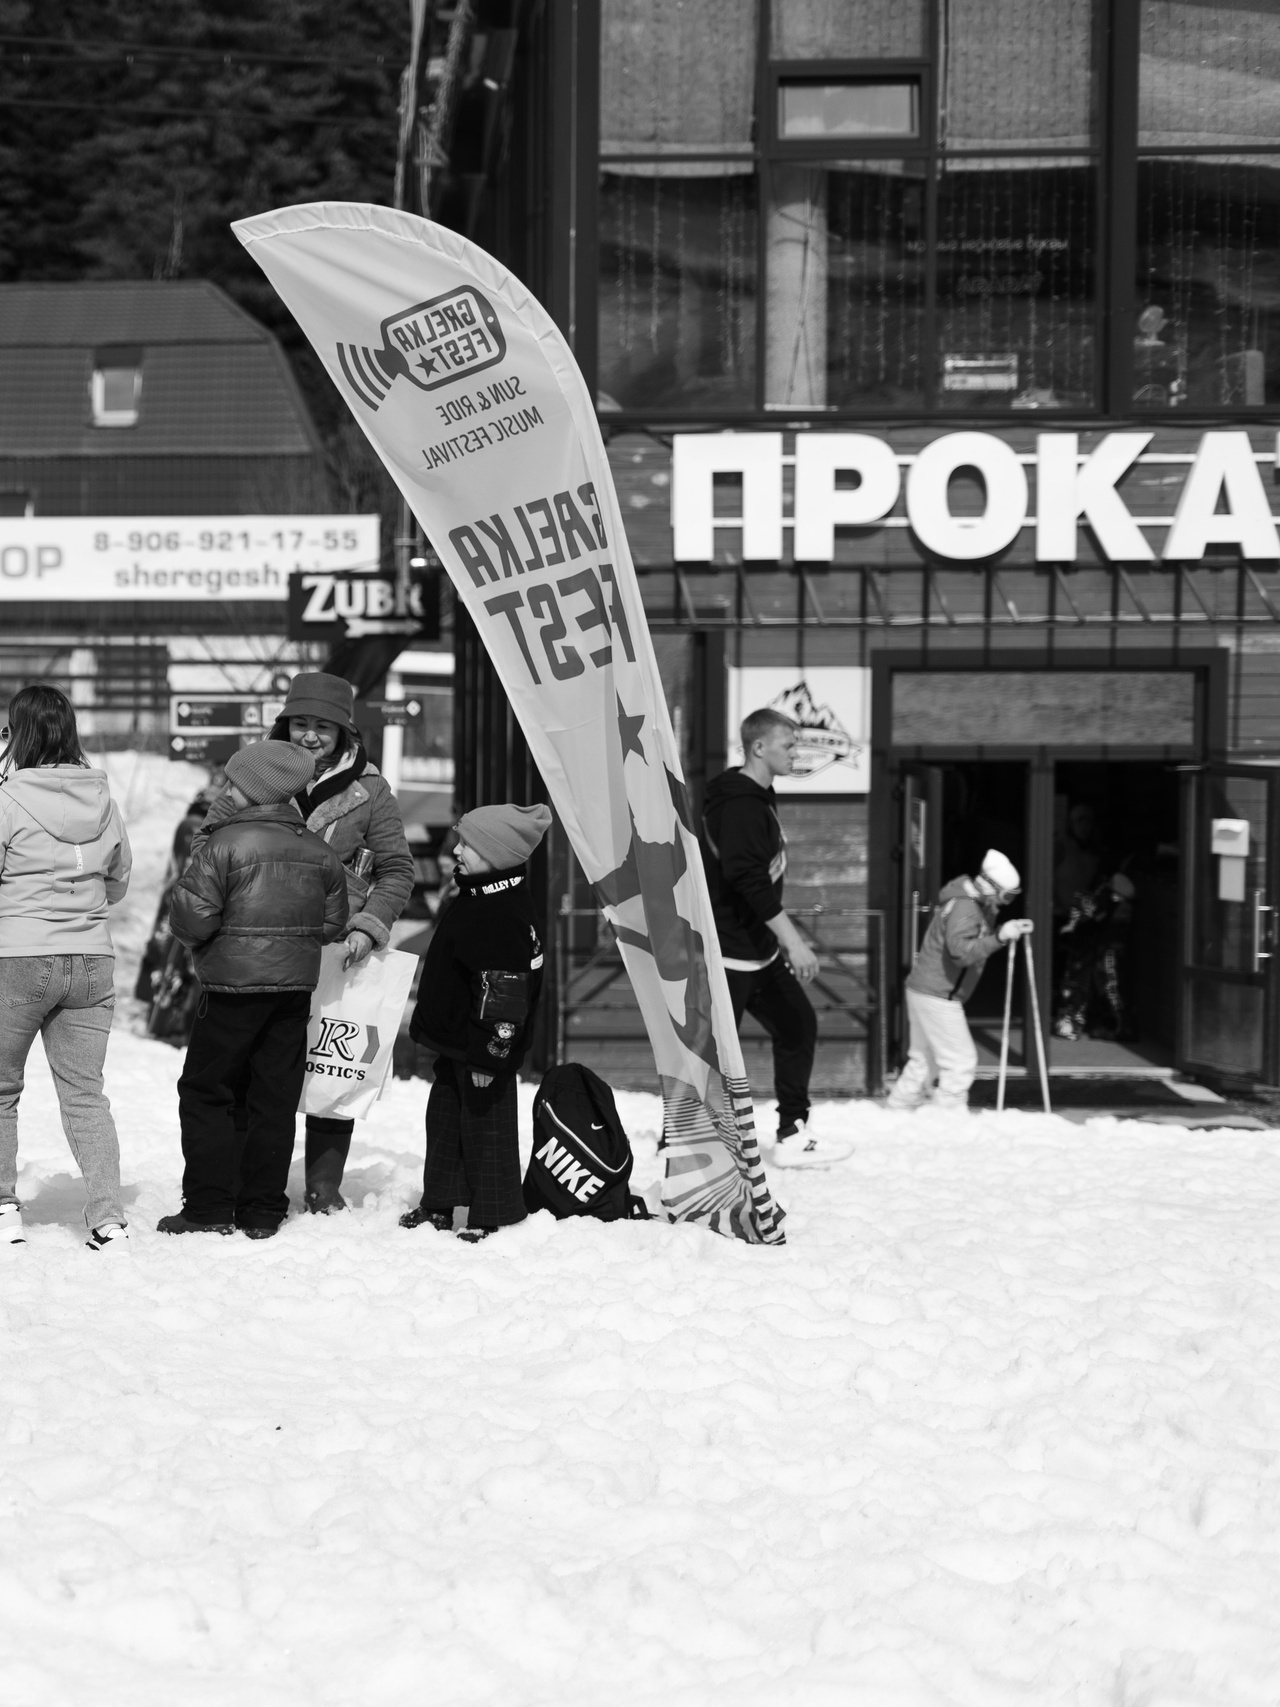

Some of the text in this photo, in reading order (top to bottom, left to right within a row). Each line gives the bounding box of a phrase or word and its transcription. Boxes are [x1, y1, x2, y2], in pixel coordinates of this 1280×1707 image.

[672, 431, 1280, 563] ПРОКА
[94, 529, 359, 552] 8-906-921-17-55
[309, 1017, 360, 1061] R
[305, 1061, 366, 1081] OSTIC'S
[535, 1136, 605, 1204] NIKE
